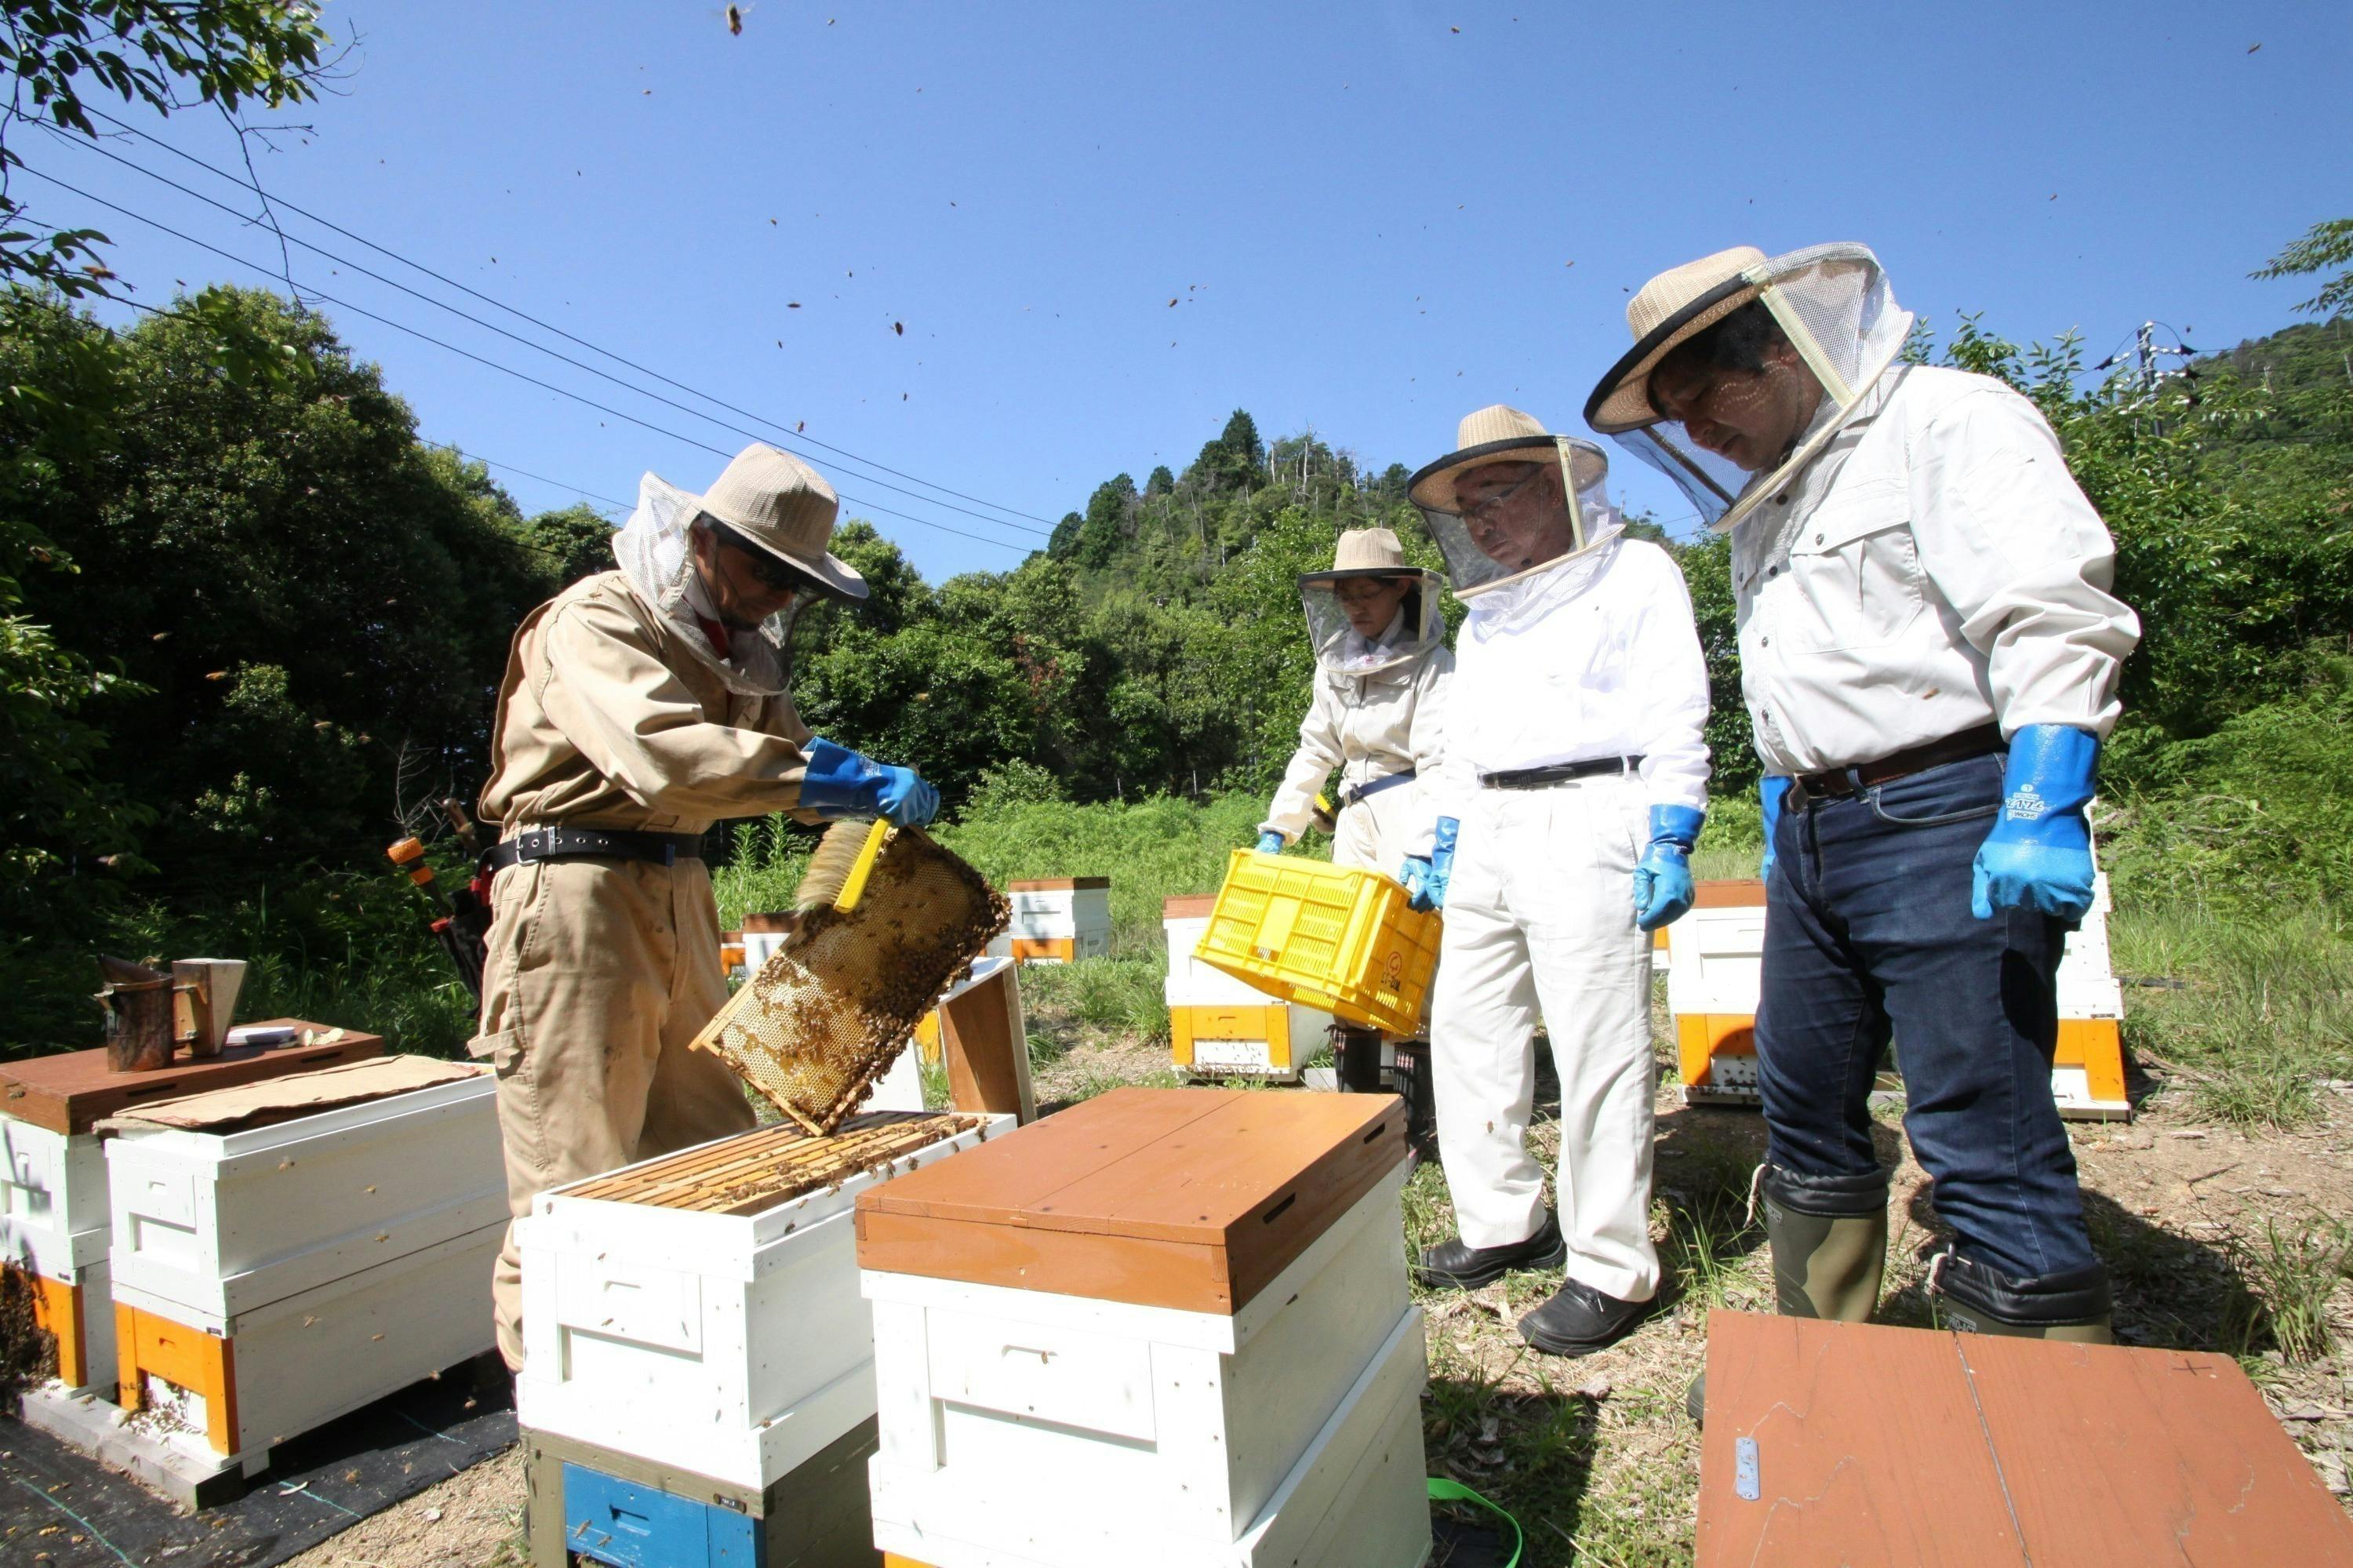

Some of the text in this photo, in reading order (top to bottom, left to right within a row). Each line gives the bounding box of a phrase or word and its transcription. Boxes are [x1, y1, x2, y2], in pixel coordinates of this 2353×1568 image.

[2006, 799, 2044, 810] テムレス
[2013, 810, 2038, 820] SHOWA
